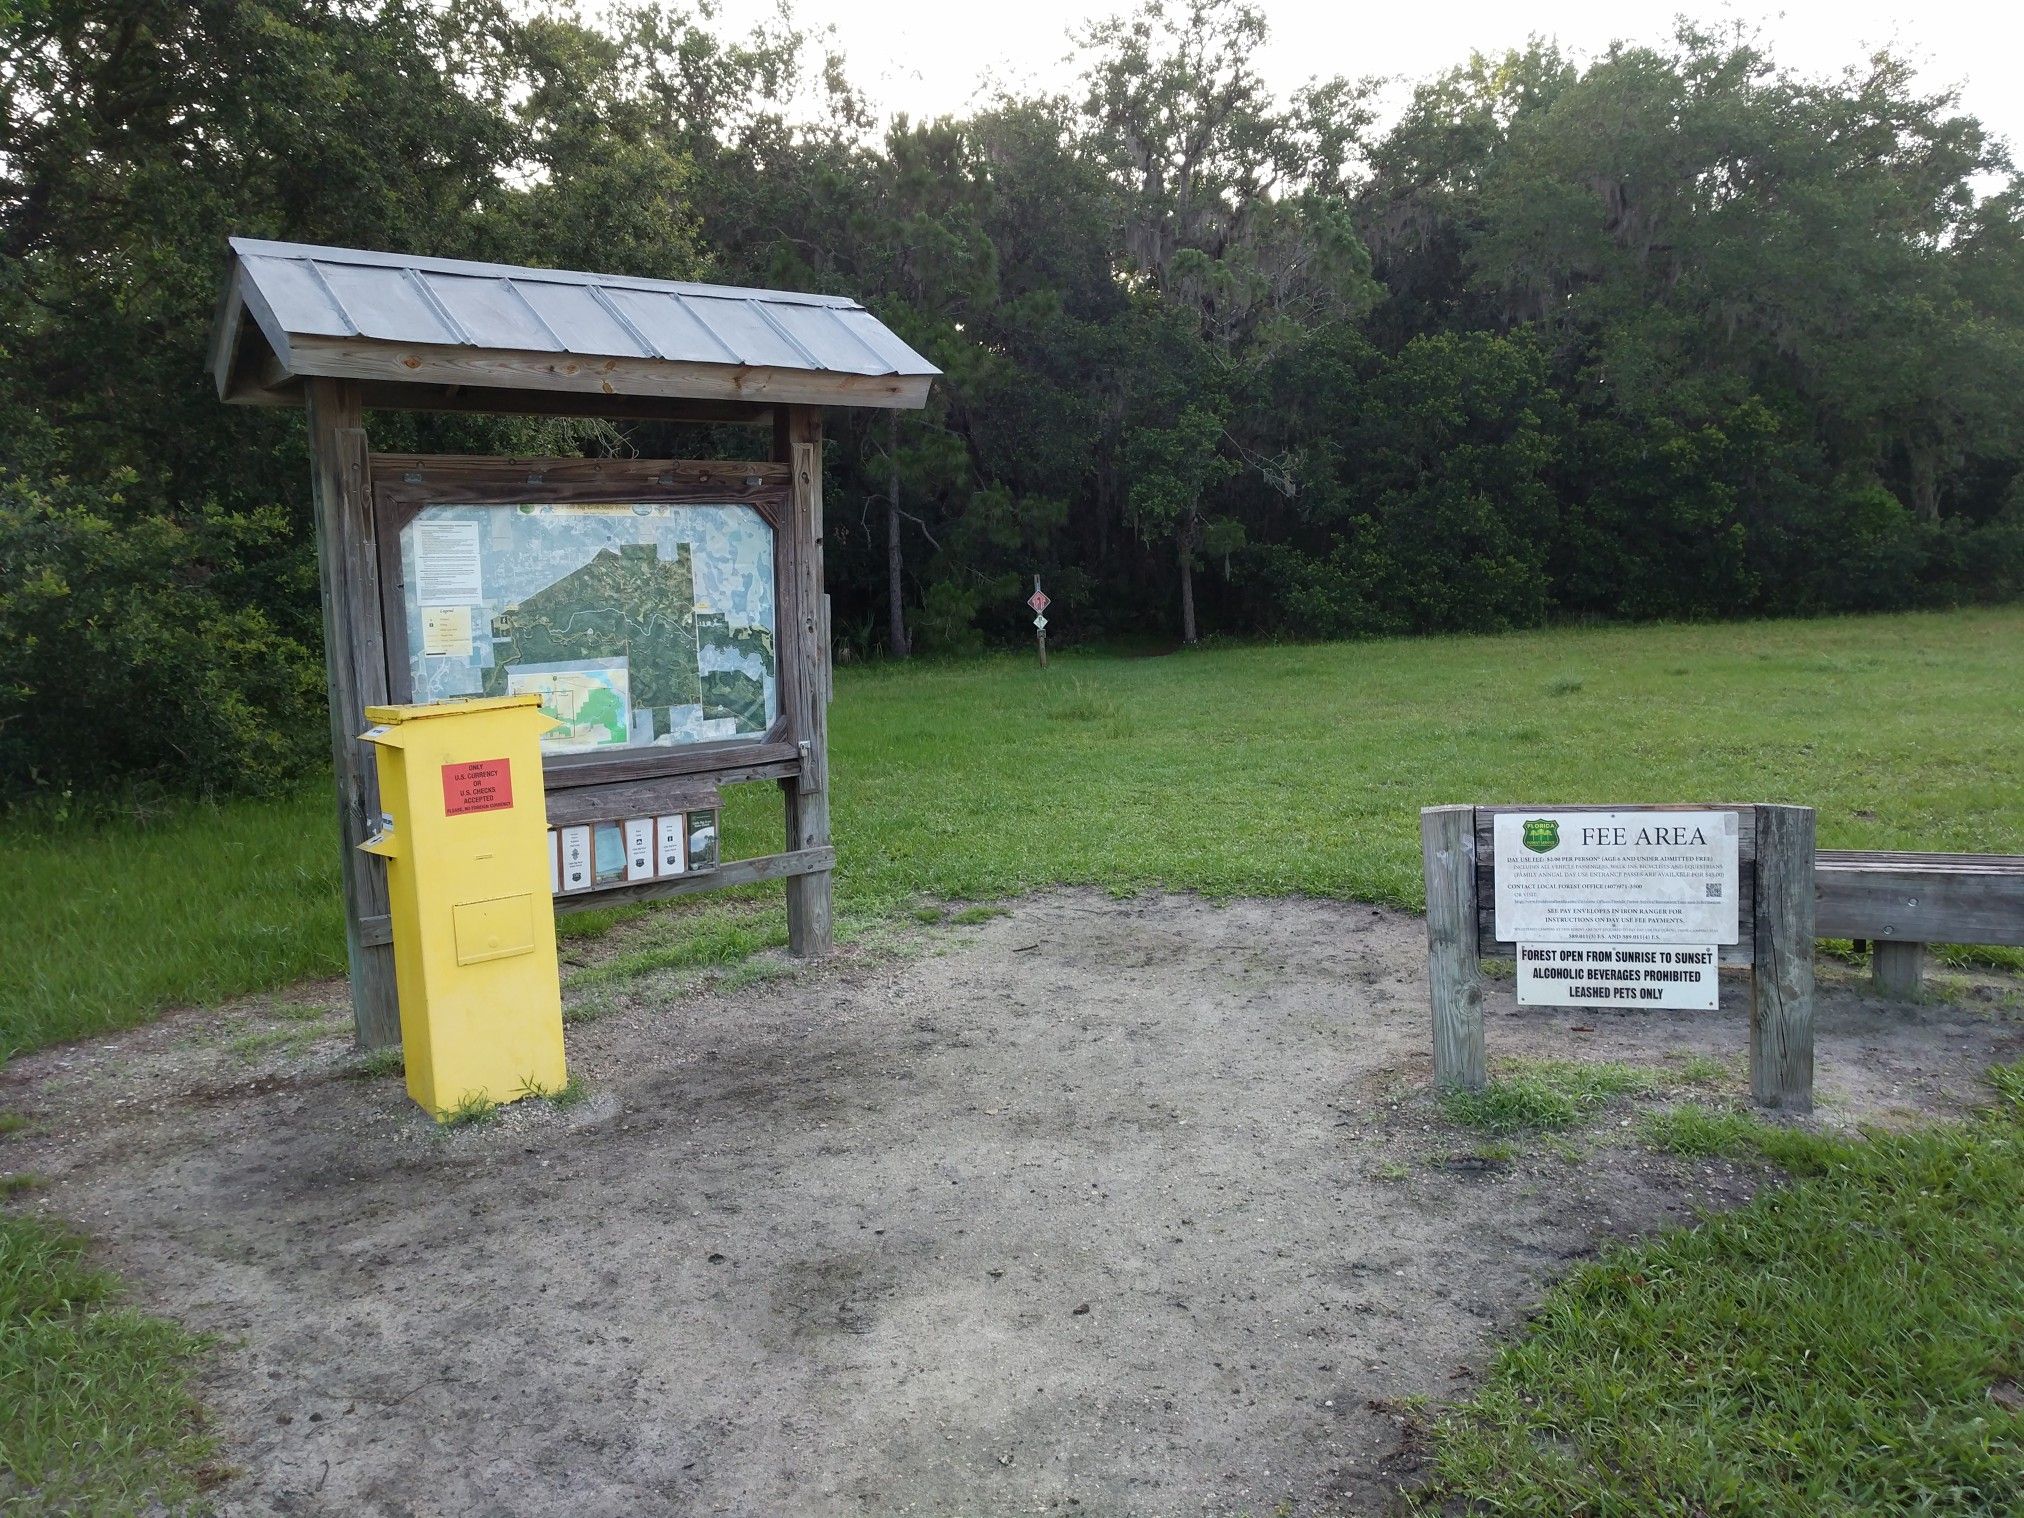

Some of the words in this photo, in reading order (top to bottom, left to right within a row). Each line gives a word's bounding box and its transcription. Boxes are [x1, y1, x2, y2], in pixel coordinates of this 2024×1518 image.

[455, 773, 466, 781] U.S.
[467, 770, 498, 779] CURRENCY
[460, 789, 471, 797] U.S.
[473, 787, 496, 795] CHECKS
[464, 795, 494, 804] ACCEPTED
[1582, 828, 1627, 846] FEE
[1634, 827, 1708, 846] AREA
[1522, 949, 1557, 961] FOREST
[1560, 950, 1583, 961] OPEN
[1586, 951, 1612, 962] FROM
[1615, 951, 1656, 963] SUNRISE
[1659, 952, 1672, 963] TO
[1675, 952, 1713, 964] SUNSET
[1533, 967, 1584, 979] ALCOHOLIC
[1587, 969, 1641, 981] BEVERAGES
[1644, 970, 1701, 982] PROHIBITED
[1569, 986, 1610, 998] LEASHED
[1613, 987, 1636, 999] PETS
[1640, 988, 1663, 1000] ONLY
